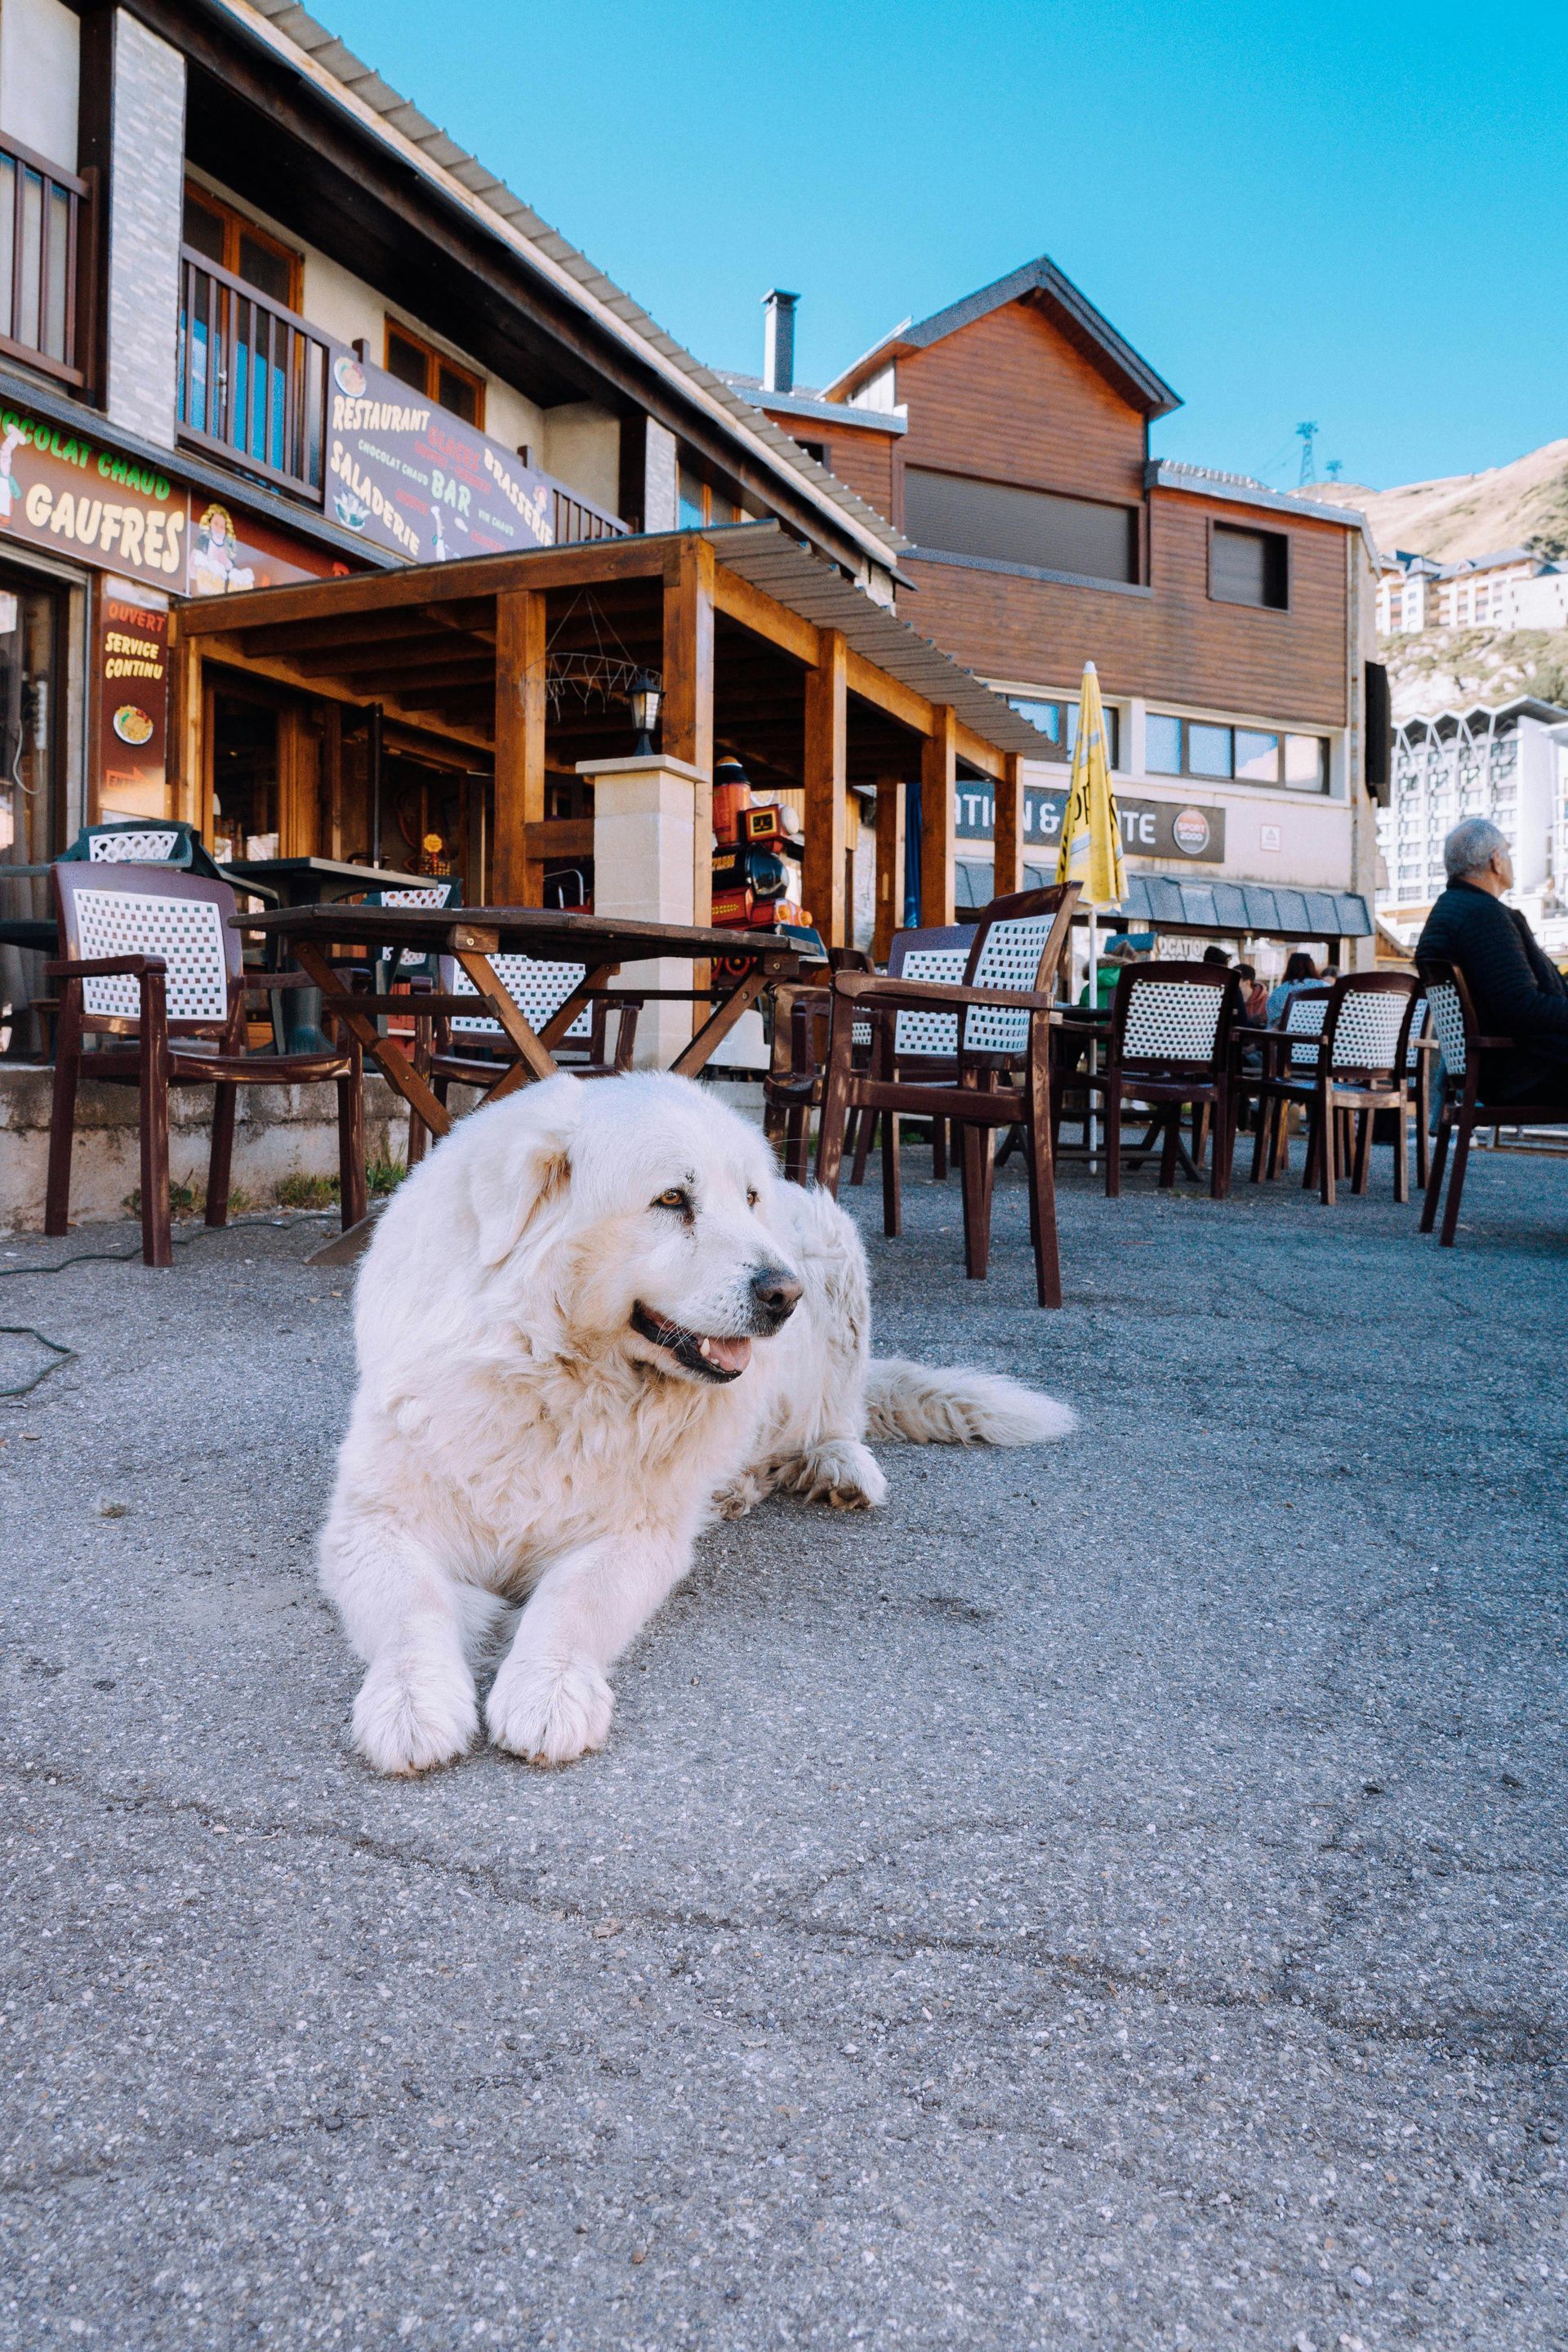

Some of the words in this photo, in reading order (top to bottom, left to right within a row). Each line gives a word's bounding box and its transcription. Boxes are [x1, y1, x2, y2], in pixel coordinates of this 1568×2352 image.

[332, 395, 430, 432] RESTAURANT
[0, 407, 92, 468] OCOLAT
[98, 451, 170, 501] CHAUD
[358, 439, 401, 470] CHOCOLAT
[402, 463, 429, 486] CHAUD
[427, 425, 481, 472] GLACES
[330, 440, 420, 556] SALADERIE
[431, 469, 471, 517] BAR
[484, 448, 553, 546] BRASSERIE
[25, 483, 185, 573] GAUFRES
[108, 603, 166, 632] OUVERT
[105, 631, 159, 659] SERVICE
[105, 658, 163, 679] CONTINU
[1040, 802, 1060, 834] &
[1178, 822, 1205, 833] SPORT
[1179, 831, 1204, 841] 2000
